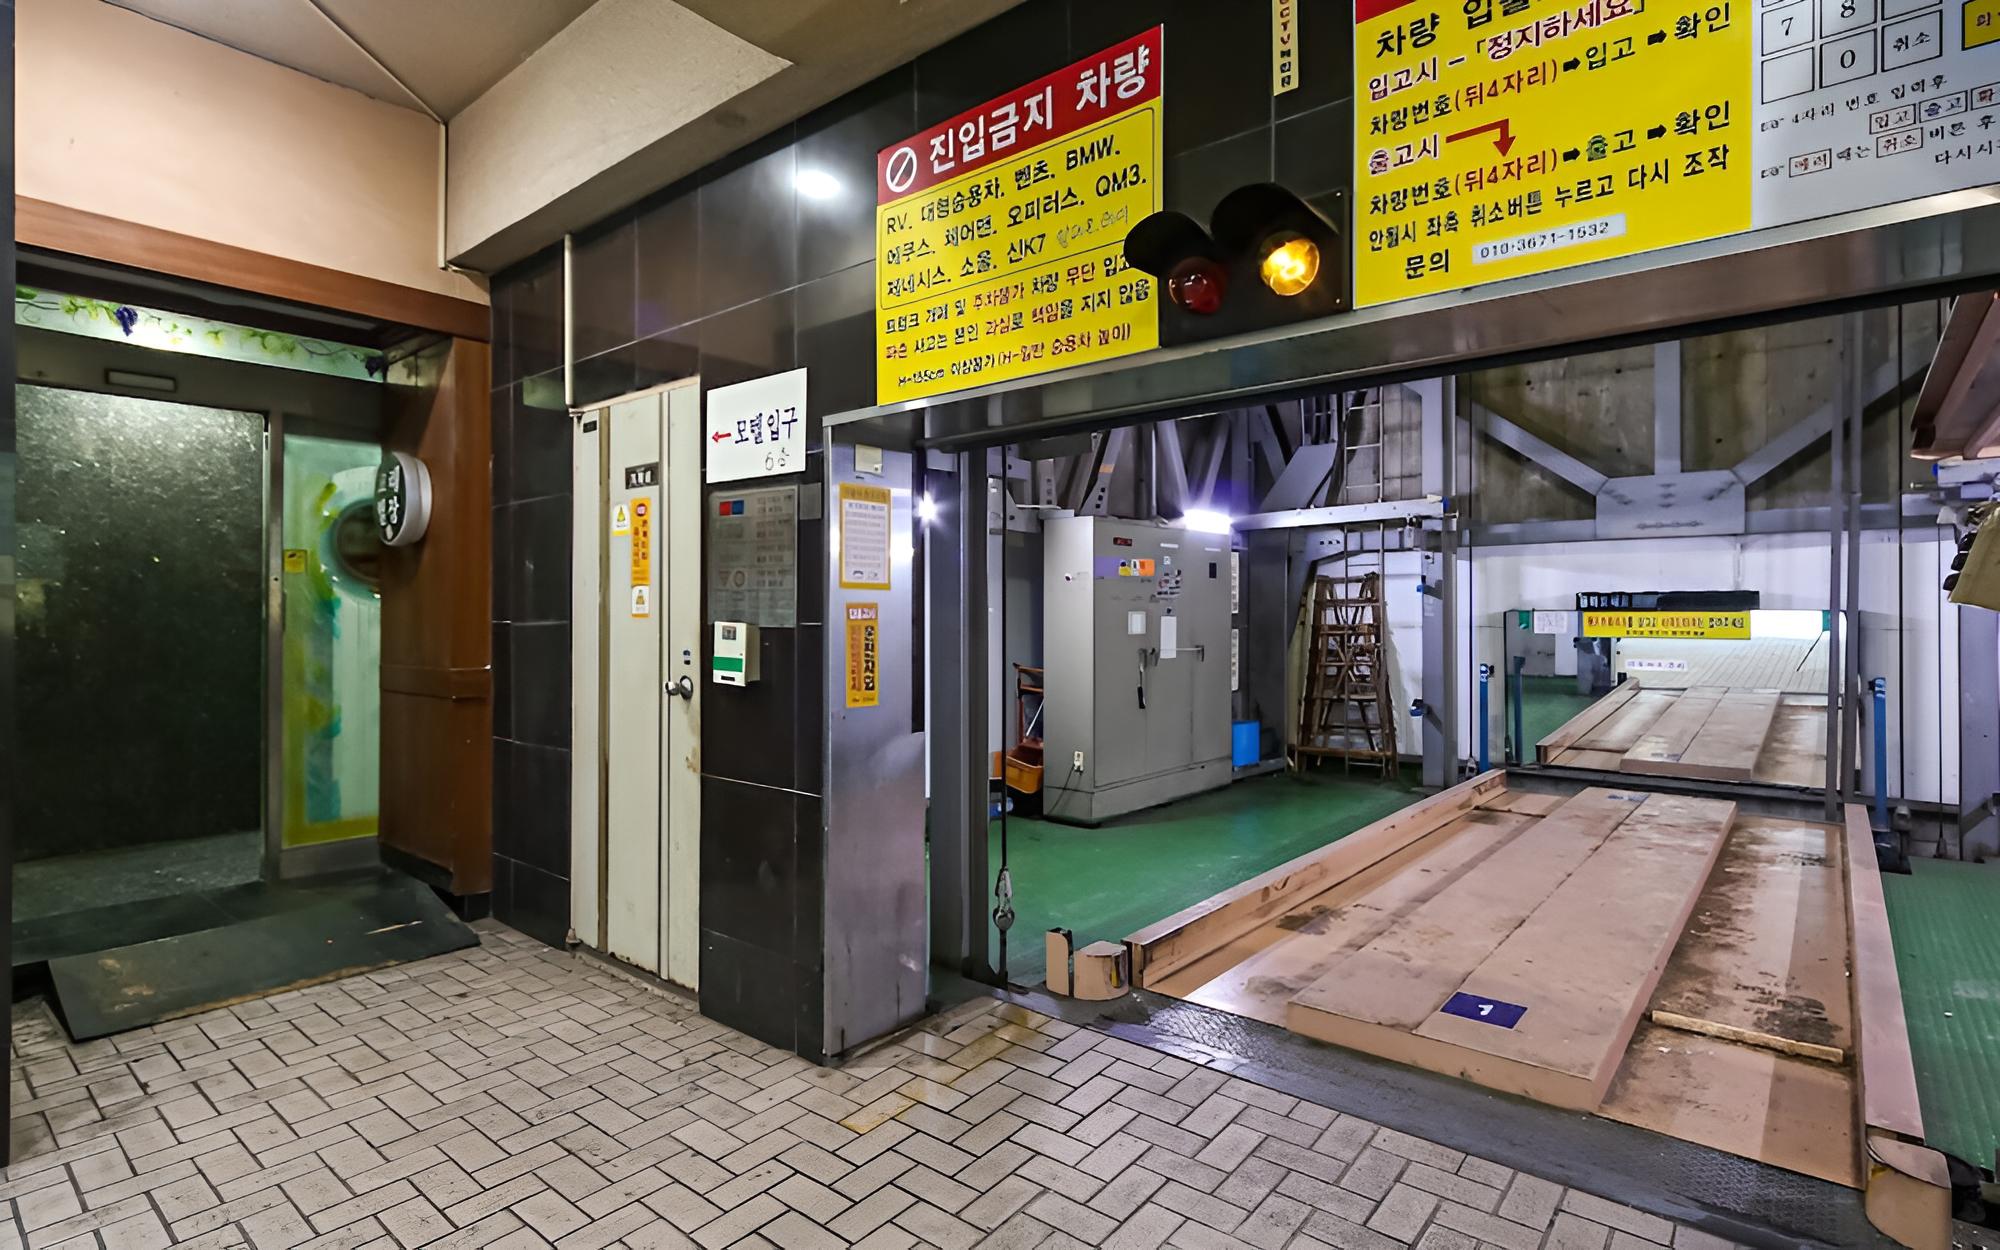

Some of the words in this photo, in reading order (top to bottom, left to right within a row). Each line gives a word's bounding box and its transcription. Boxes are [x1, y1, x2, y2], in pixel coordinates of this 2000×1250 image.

[1781, 17, 1794, 36] 7
[1840, 0, 1856, 18] 8
[1375, 12, 1440, 59] 차량
[1586, 36, 1636, 71] 입고
[1674, 2, 1730, 40] 확인
[1893, 31, 1931, 52] 취소
[1369, 57, 1437, 101] 입고시
[1840, 49, 1856, 69] 0
[929, 85, 1053, 174] 진입금지
[1076, 44, 1150, 111] 차량
[1066, 134, 1121, 171] BMW.
[1586, 129, 1637, 163] 출고
[1674, 100, 1730, 136] 확인
[1369, 133, 1437, 175] 출고시
[1006, 186, 1085, 228] 오피러스.
[1095, 163, 1147, 197] QM3.
[1554, 174, 1615, 210] 누르고
[1628, 158, 1670, 191] 다시
[1682, 144, 1730, 178] 조작
[1066, 261, 1096, 286] 무단
[1405, 248, 1450, 280] 문의
[954, 322, 979, 346] 본인
[1080, 288, 1111, 313] 지지
